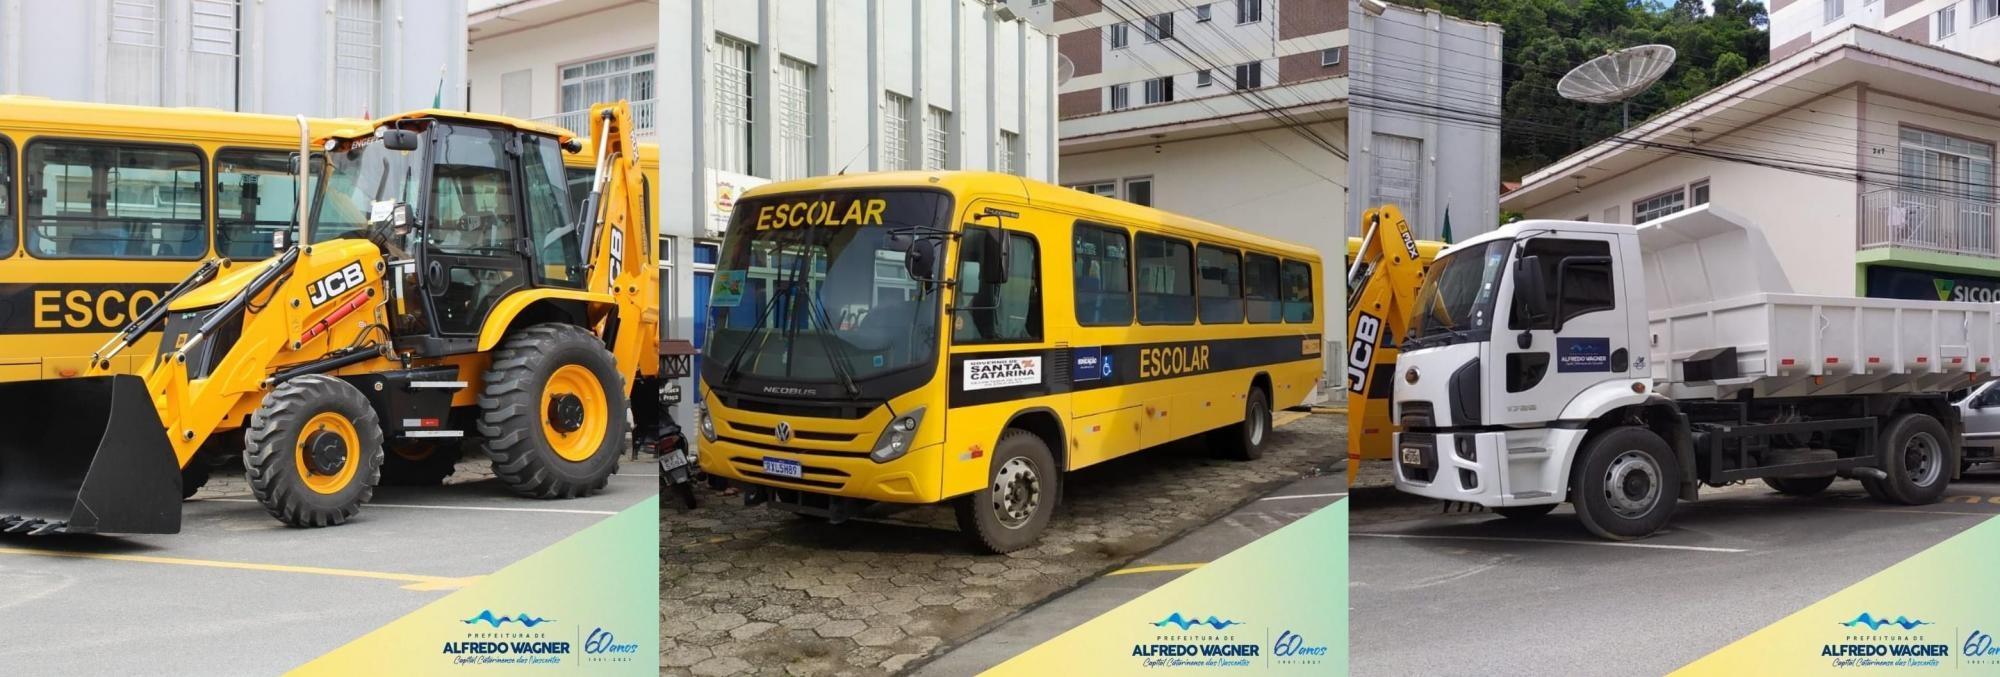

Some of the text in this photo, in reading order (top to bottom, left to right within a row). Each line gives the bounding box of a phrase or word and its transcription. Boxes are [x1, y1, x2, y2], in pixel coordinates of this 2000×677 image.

[756, 199, 886, 231] ESCOLAR
[311, 262, 365, 305] JCB
[971, 363, 1021, 373] SANTA
[1139, 344, 1210, 378] ESCOLAR
[1348, 314, 1379, 391] JCB
[763, 386, 816, 395] NEOBUS
[971, 369, 1035, 380] CATARINA
